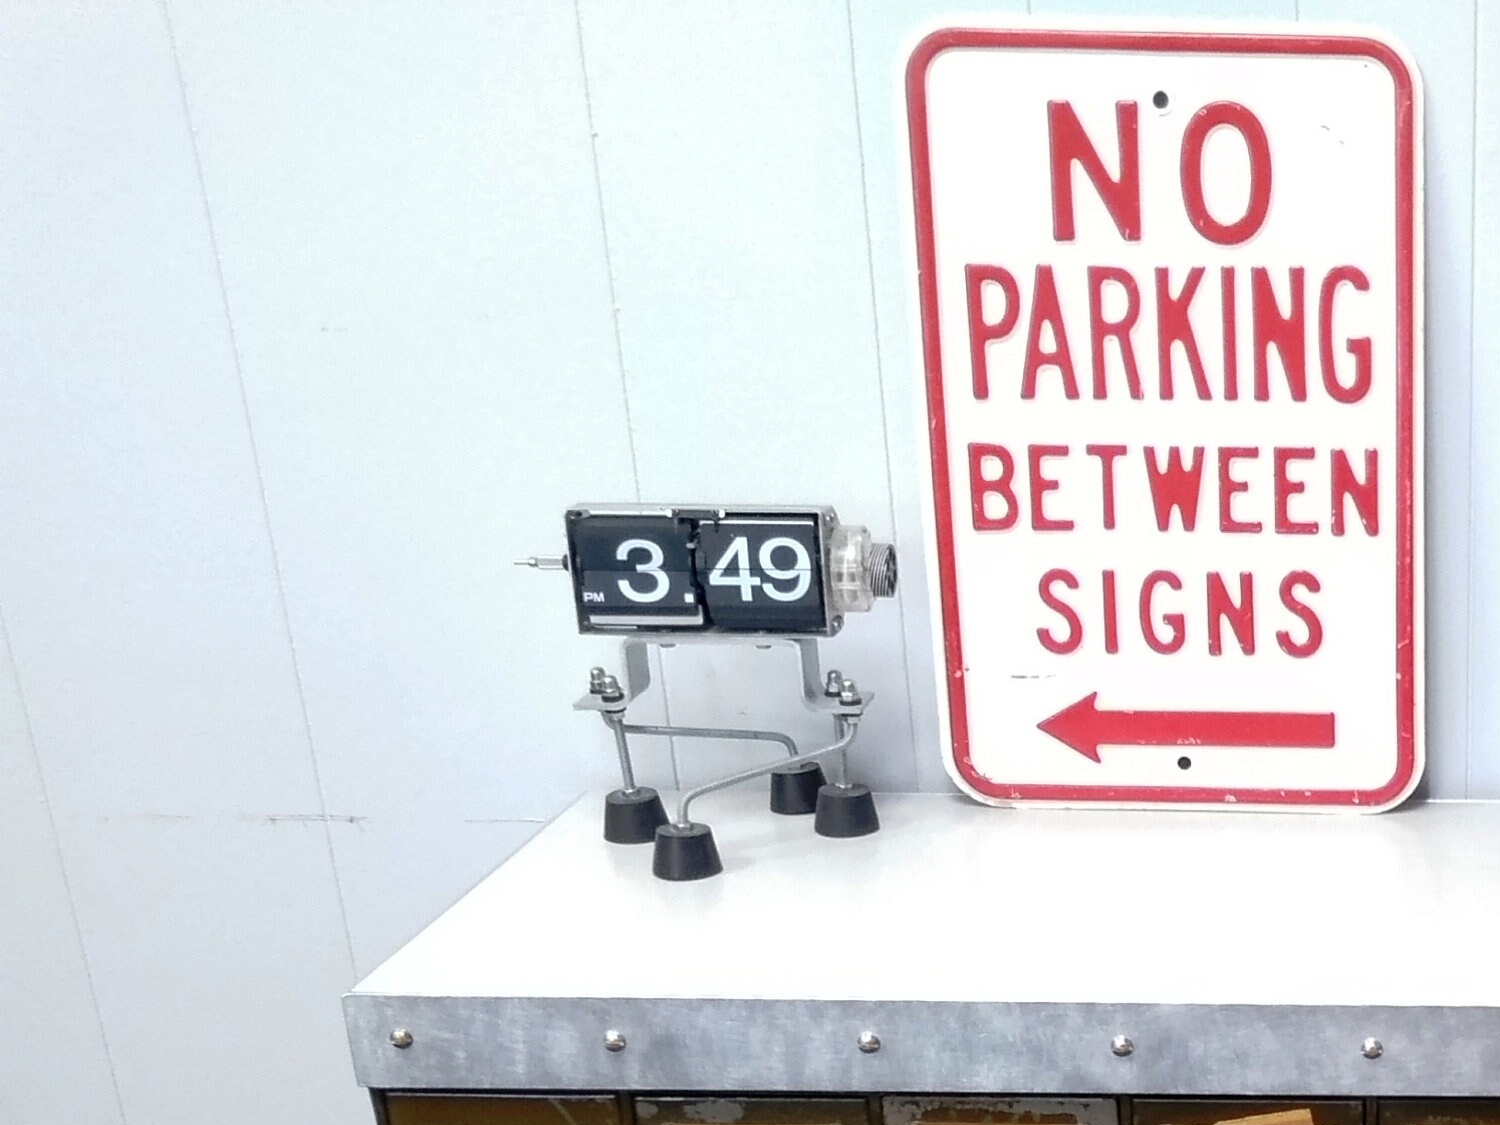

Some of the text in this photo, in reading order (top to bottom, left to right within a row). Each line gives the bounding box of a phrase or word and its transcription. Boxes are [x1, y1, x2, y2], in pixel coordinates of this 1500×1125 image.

[1046, 100, 1272, 246] NO
[965, 263, 1372, 404] PARKING
[968, 442, 1379, 537] BETWEEN
[582, 591, 606, 603] PM
[615, 536, 812, 603] 3 49
[1036, 568, 1323, 658] SIGNS
